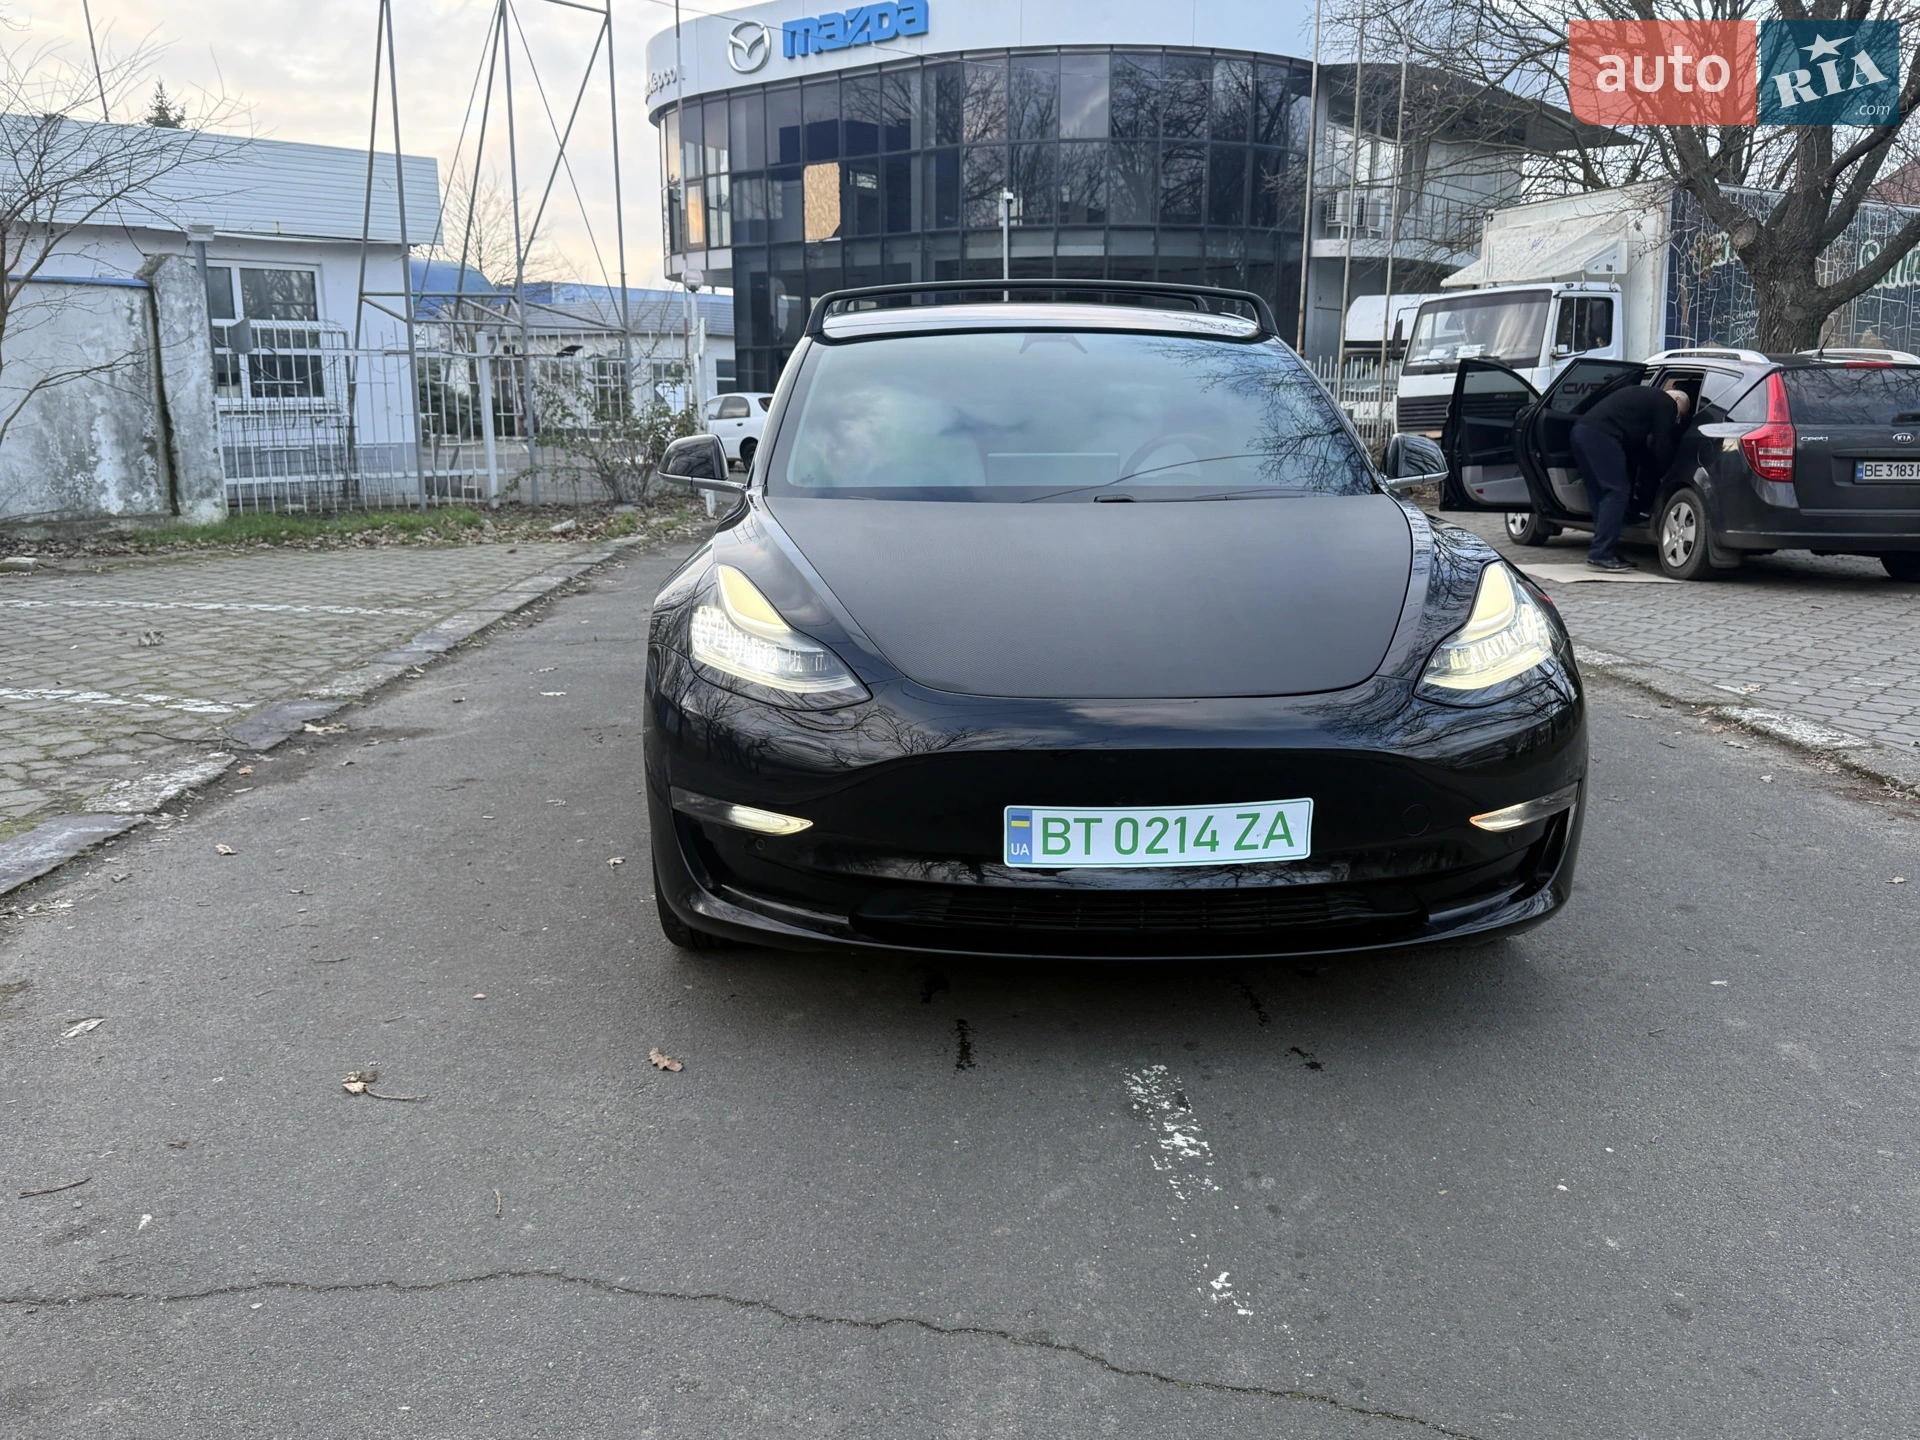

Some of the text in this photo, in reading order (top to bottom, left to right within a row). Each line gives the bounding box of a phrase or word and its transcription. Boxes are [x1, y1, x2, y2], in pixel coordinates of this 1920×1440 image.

[1896, 434, 1912, 442] KIA
[1865, 464, 1883, 477] BE
[1886, 464, 1914, 477] 3183
[1042, 811, 1294, 855] BT 0214 ZA
[1011, 843, 1030, 856] UA
